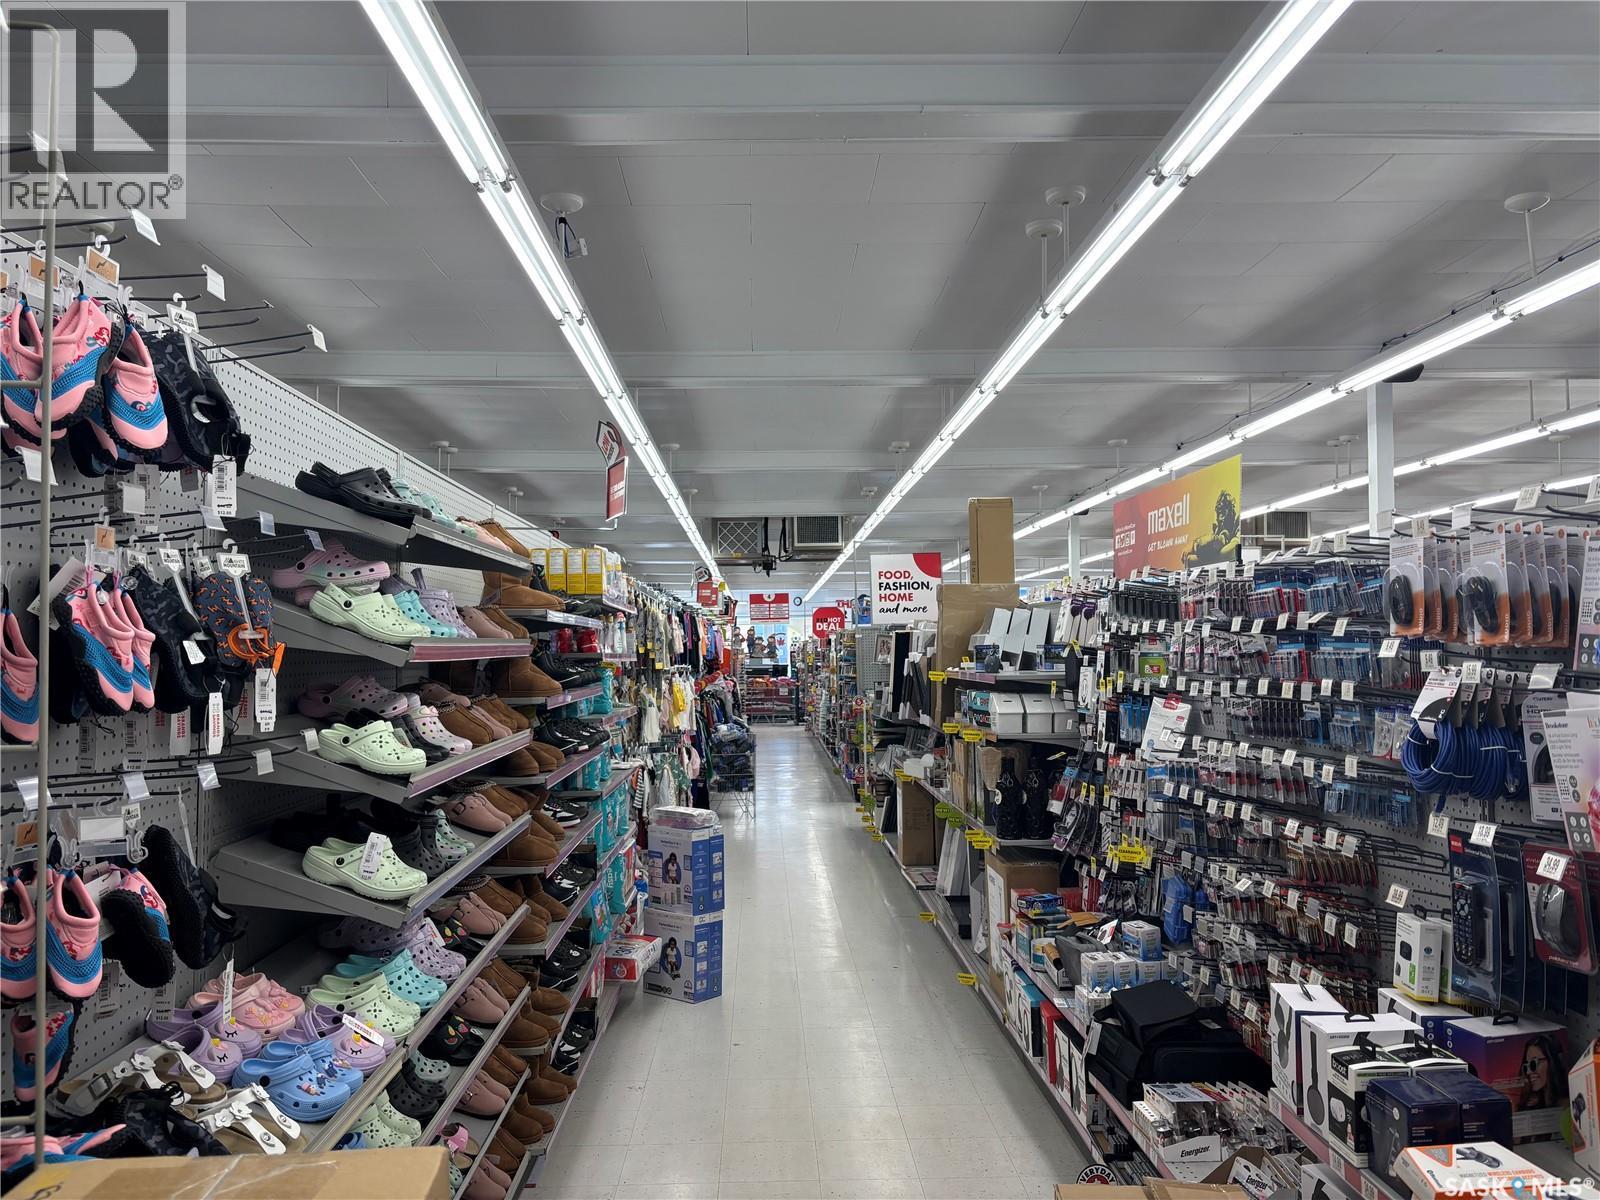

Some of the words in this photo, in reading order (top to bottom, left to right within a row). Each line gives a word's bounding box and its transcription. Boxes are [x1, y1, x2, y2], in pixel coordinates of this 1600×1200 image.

[1147, 491, 1190, 535] maxell
[1147, 542, 1157, 553] GET
[878, 570, 914, 581] FOOD,
[878, 581, 933, 591] FASHION,
[879, 593, 914, 602] HOME
[879, 603, 900, 614] and
[902, 605, 928, 613] more
[816, 622, 842, 630] DEAL
[1455, 868, 1461, 876] 4
[1180, 1145, 1211, 1158] Energizer
